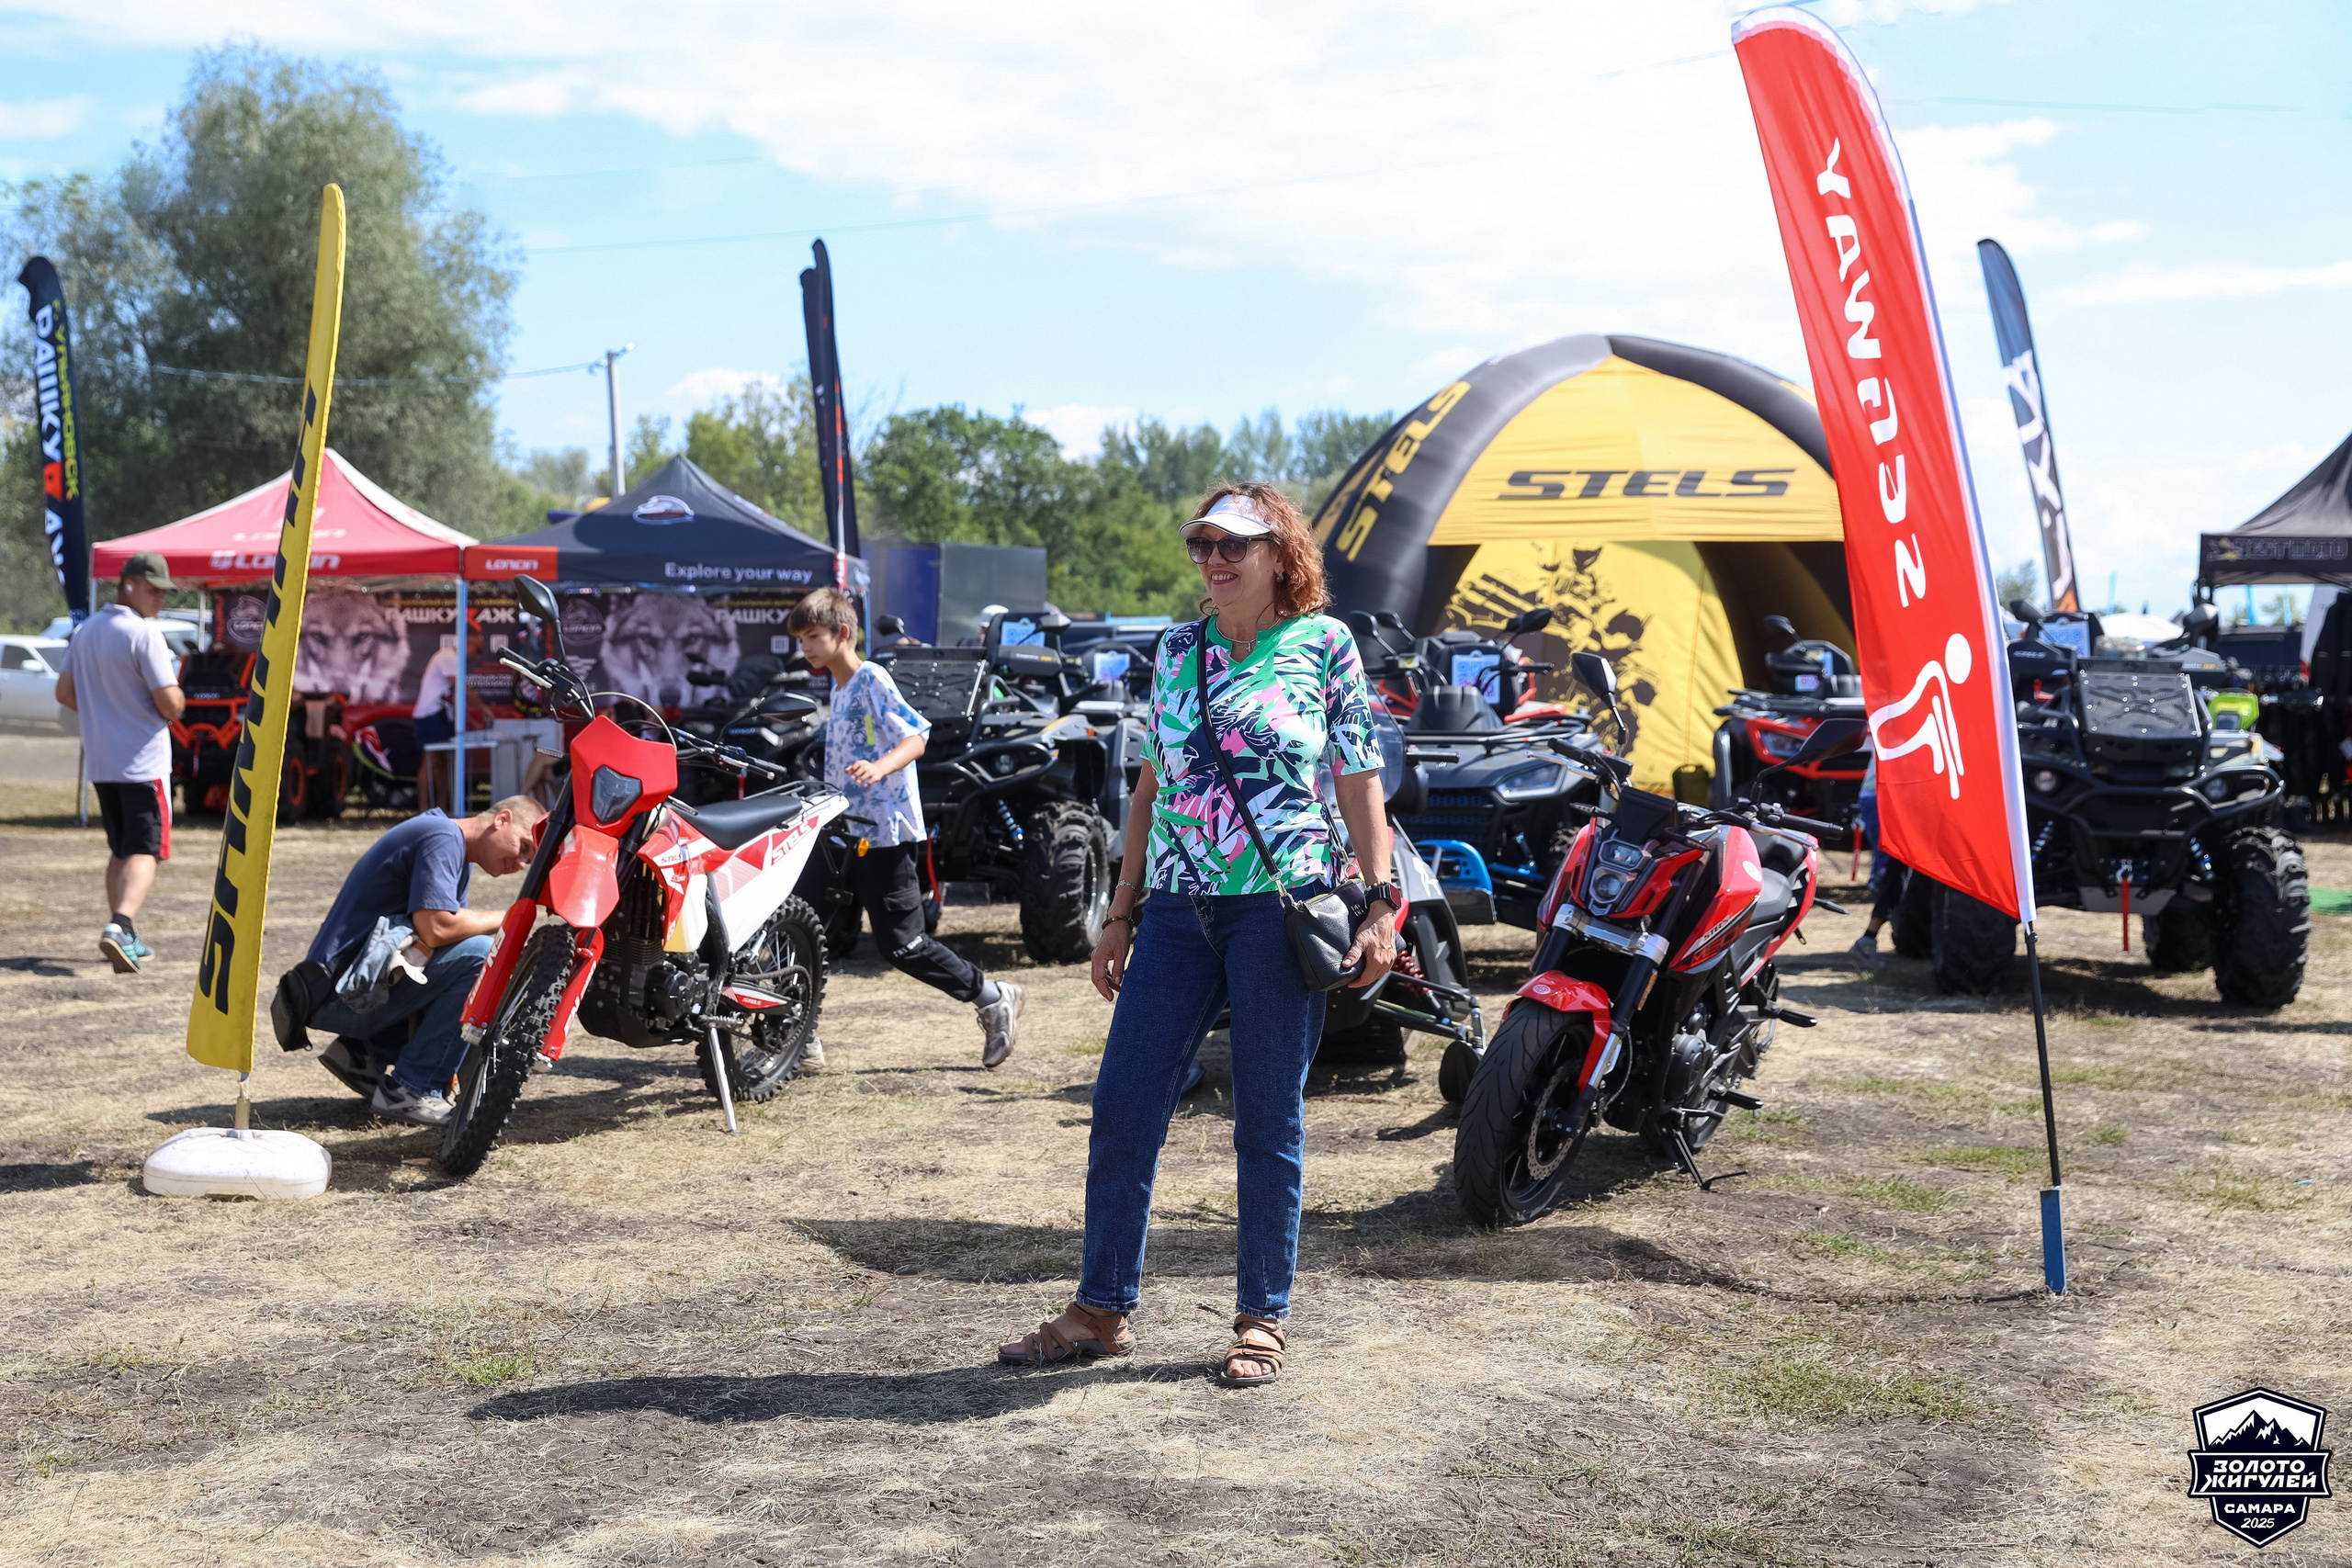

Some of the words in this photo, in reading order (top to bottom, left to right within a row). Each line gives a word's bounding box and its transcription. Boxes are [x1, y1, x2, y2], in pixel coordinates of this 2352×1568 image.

[1335, 380, 1472, 562] STELS
[1498, 468, 1795, 500] STELS
[664, 561, 731, 581] Explore
[733, 565, 774, 582] your
[776, 569, 813, 585] way
[772, 819, 813, 863] STELS
